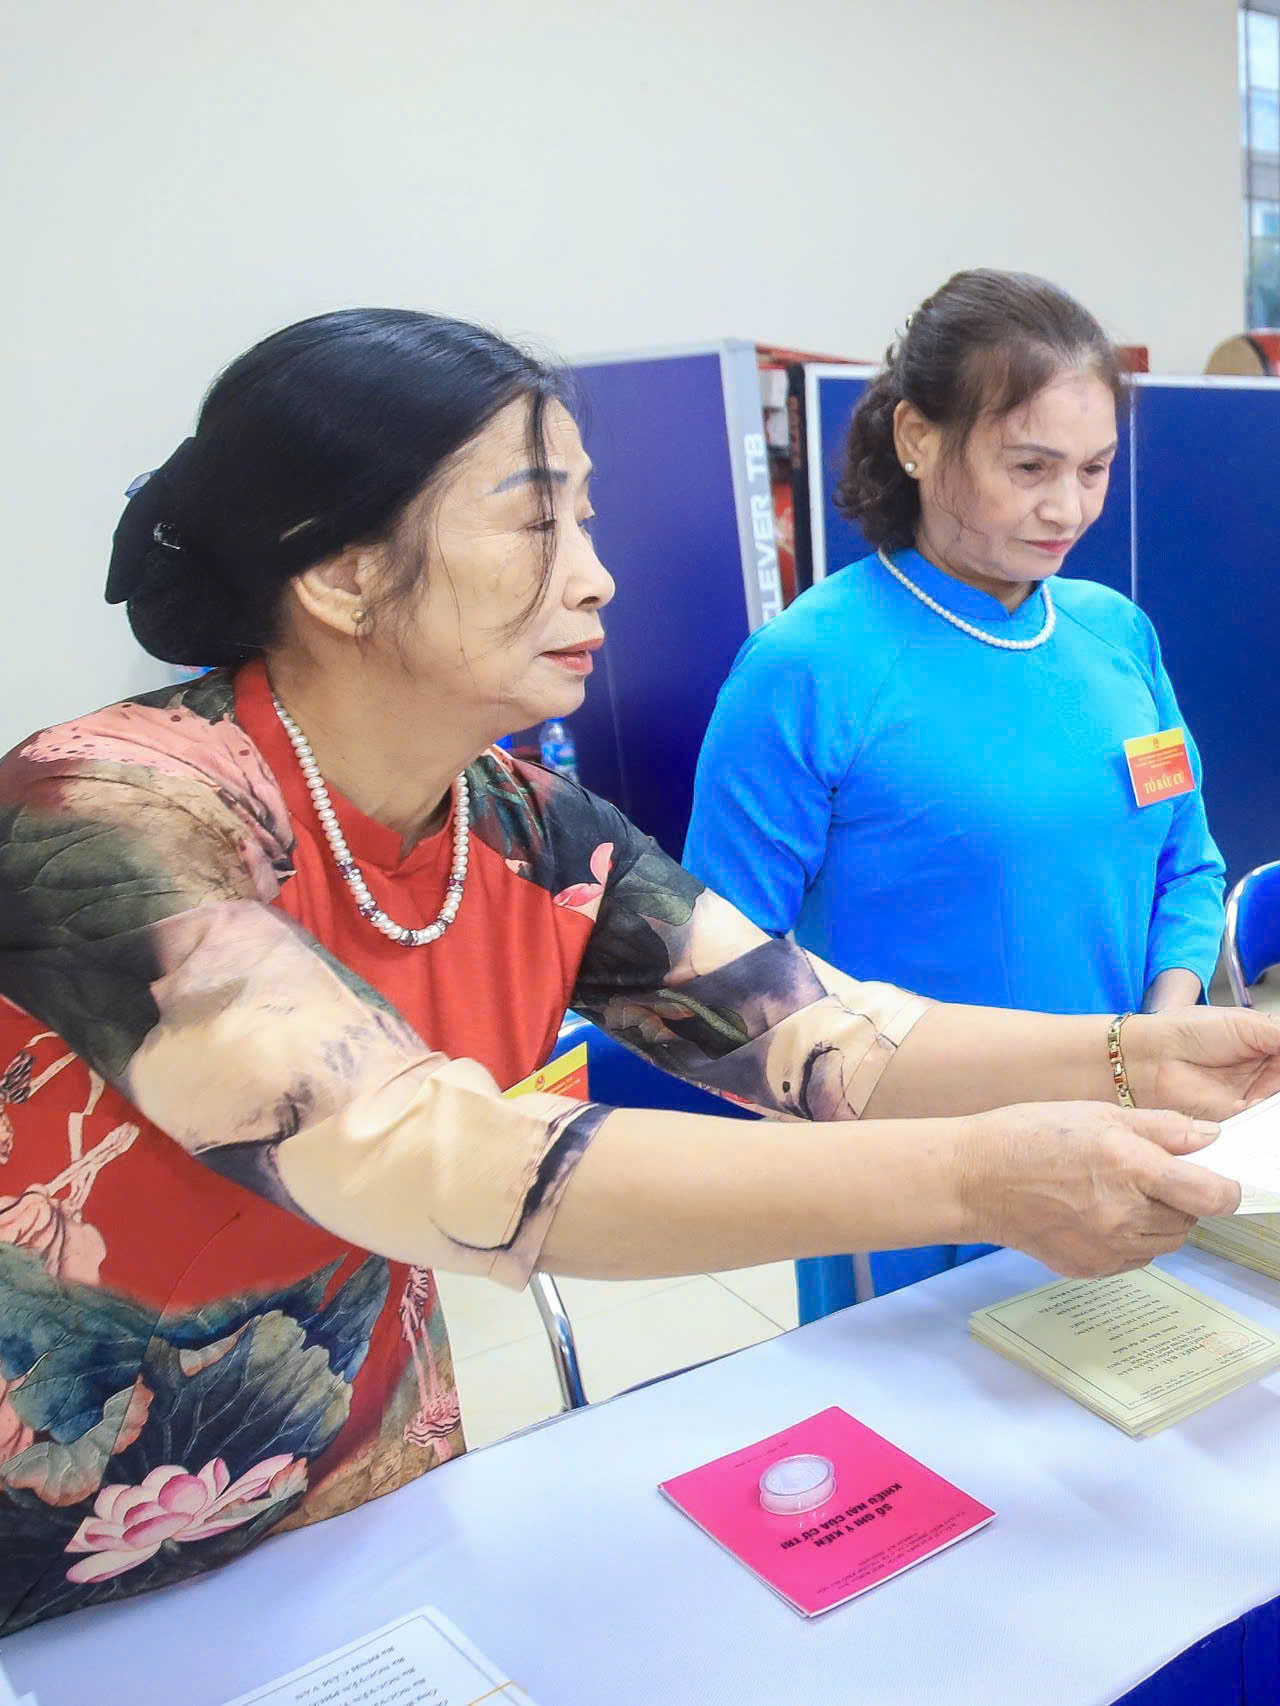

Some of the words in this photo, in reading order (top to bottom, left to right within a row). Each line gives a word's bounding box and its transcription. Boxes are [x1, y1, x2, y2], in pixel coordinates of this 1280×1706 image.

[743, 432, 767, 483] TB
[868, 1483, 902, 1504] KHIẾU
[845, 1503, 868, 1516] NẠI
[875, 1503, 892, 1516] SỔ
[819, 1515, 845, 1529] CỦA
[853, 1513, 875, 1526] GHI
[801, 1528, 820, 1541] CỬ
[814, 1530, 844, 1547] KIẾN
[781, 1537, 801, 1549] TRI
